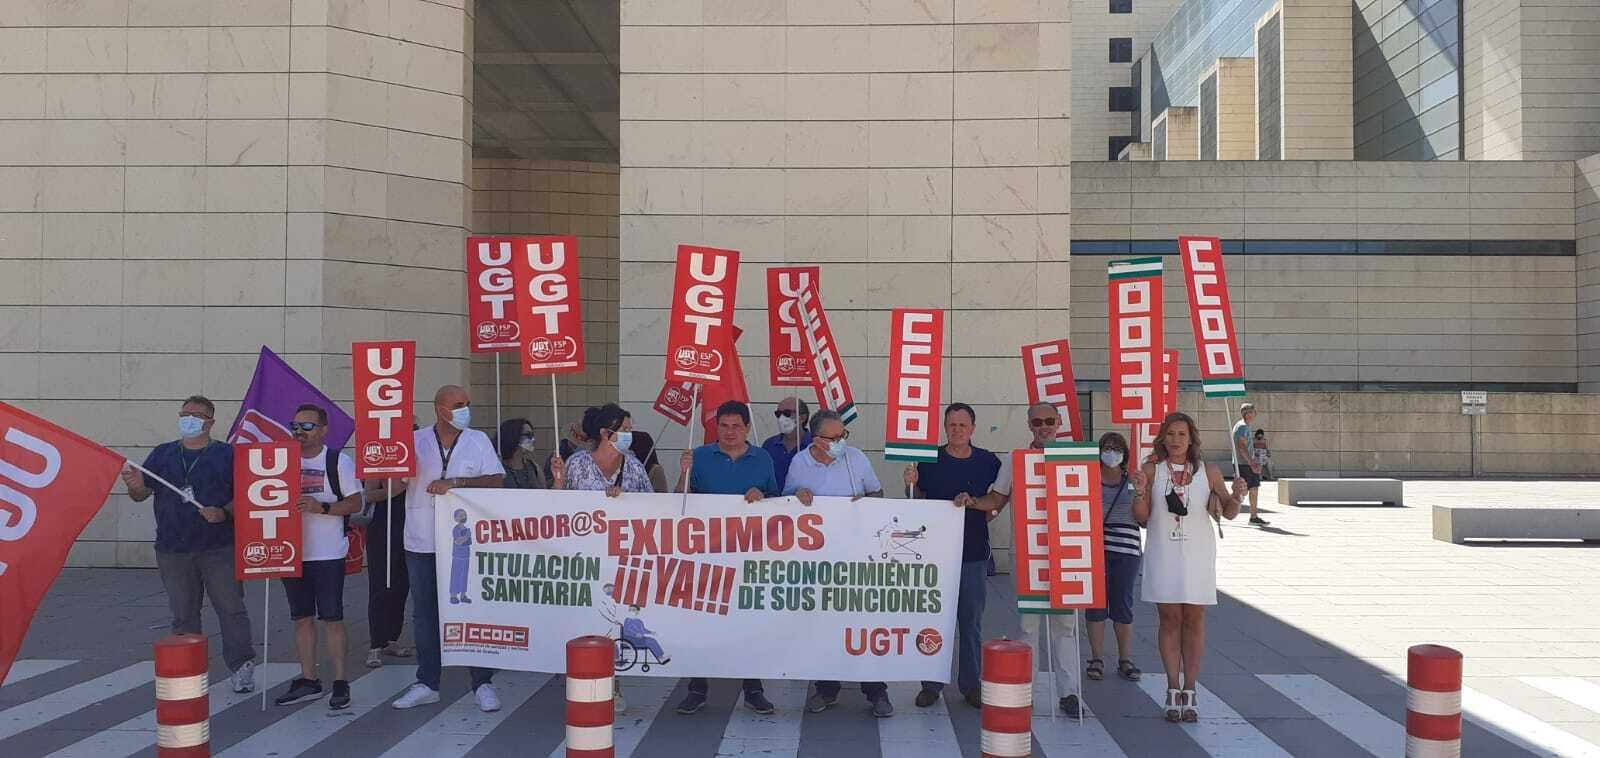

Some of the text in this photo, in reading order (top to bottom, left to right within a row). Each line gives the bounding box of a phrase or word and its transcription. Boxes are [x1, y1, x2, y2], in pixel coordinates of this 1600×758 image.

[478, 242, 514, 319] UGT
[527, 242, 569, 335] UGT
[684, 252, 728, 346] UGT
[1188, 240, 1234, 375] CCOO
[897, 312, 933, 441] CCOO
[1118, 280, 1153, 420] CCOO
[367, 347, 403, 440] UGT
[248, 447, 290, 540] UGT
[475, 509, 825, 556] CELADOR@S EXIGIMOS
[1055, 464, 1094, 605] CCOO
[475, 551, 601, 581] TITULACIÓN
[481, 577, 592, 607] SANITARIA
[738, 585, 942, 614] DE SUS FUNCIONES
[743, 559, 938, 588] RECONOCIMIENTO
[469, 627, 514, 642] CCOO
[844, 627, 910, 656] UGT
